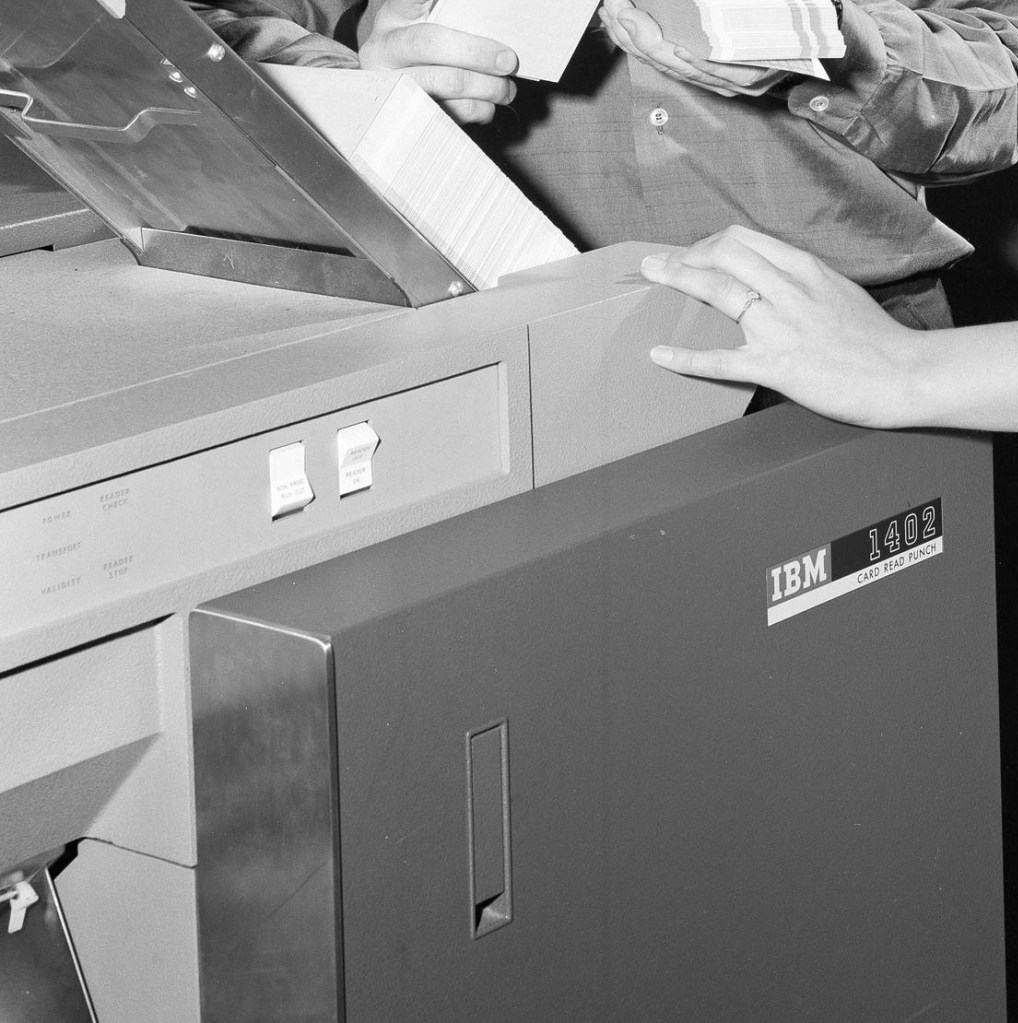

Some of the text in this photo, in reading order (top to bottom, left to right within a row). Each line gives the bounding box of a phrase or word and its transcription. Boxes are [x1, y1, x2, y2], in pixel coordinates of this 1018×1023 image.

[99, 488, 130, 503] READER
[102, 498, 128, 512] CHECK
[42, 510, 71, 525] POWER
[869, 505, 936, 562] 1402
[36, 542, 81, 561] TRANSPORT
[103, 555, 133, 571] READER
[857, 542, 937, 584] CARD READ PUNCH
[108, 566, 128, 579] STOP
[771, 548, 827, 601] IBM
[41, 577, 81, 595] VALIDITY
